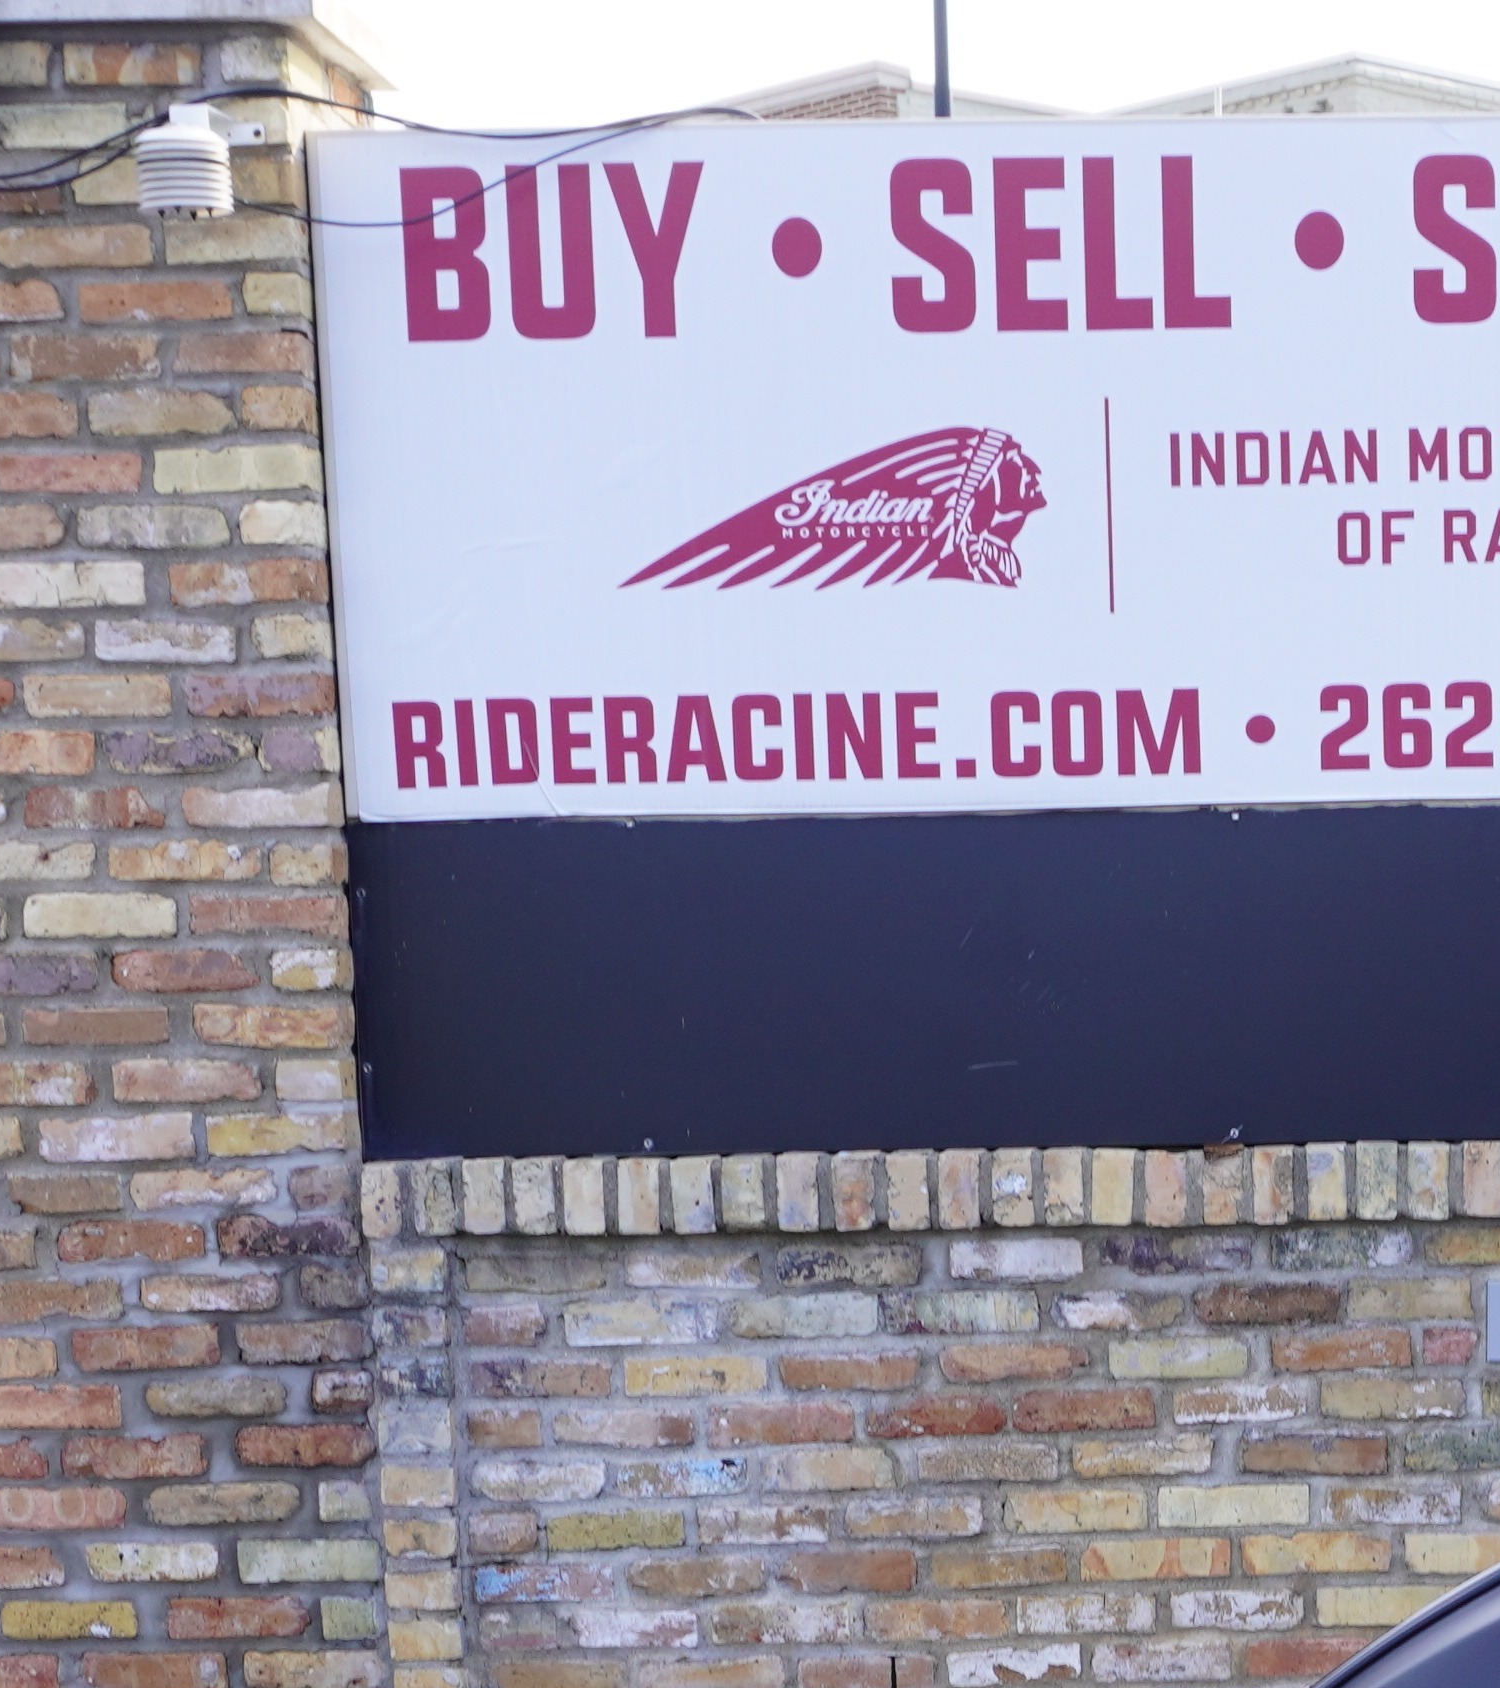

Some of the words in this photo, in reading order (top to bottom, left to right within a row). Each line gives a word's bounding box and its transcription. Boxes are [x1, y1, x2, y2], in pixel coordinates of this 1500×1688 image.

[400, 162, 703, 342] BUY
[889, 156, 1231, 333] SELL
[1170, 429, 1378, 486] INDIAN
[774, 479, 934, 525] Indian
[781, 525, 930, 540] MOTORCYCLE
[1337, 511, 1413, 565] OF
[392, 688, 1201, 789] RIDERACINE.COM
